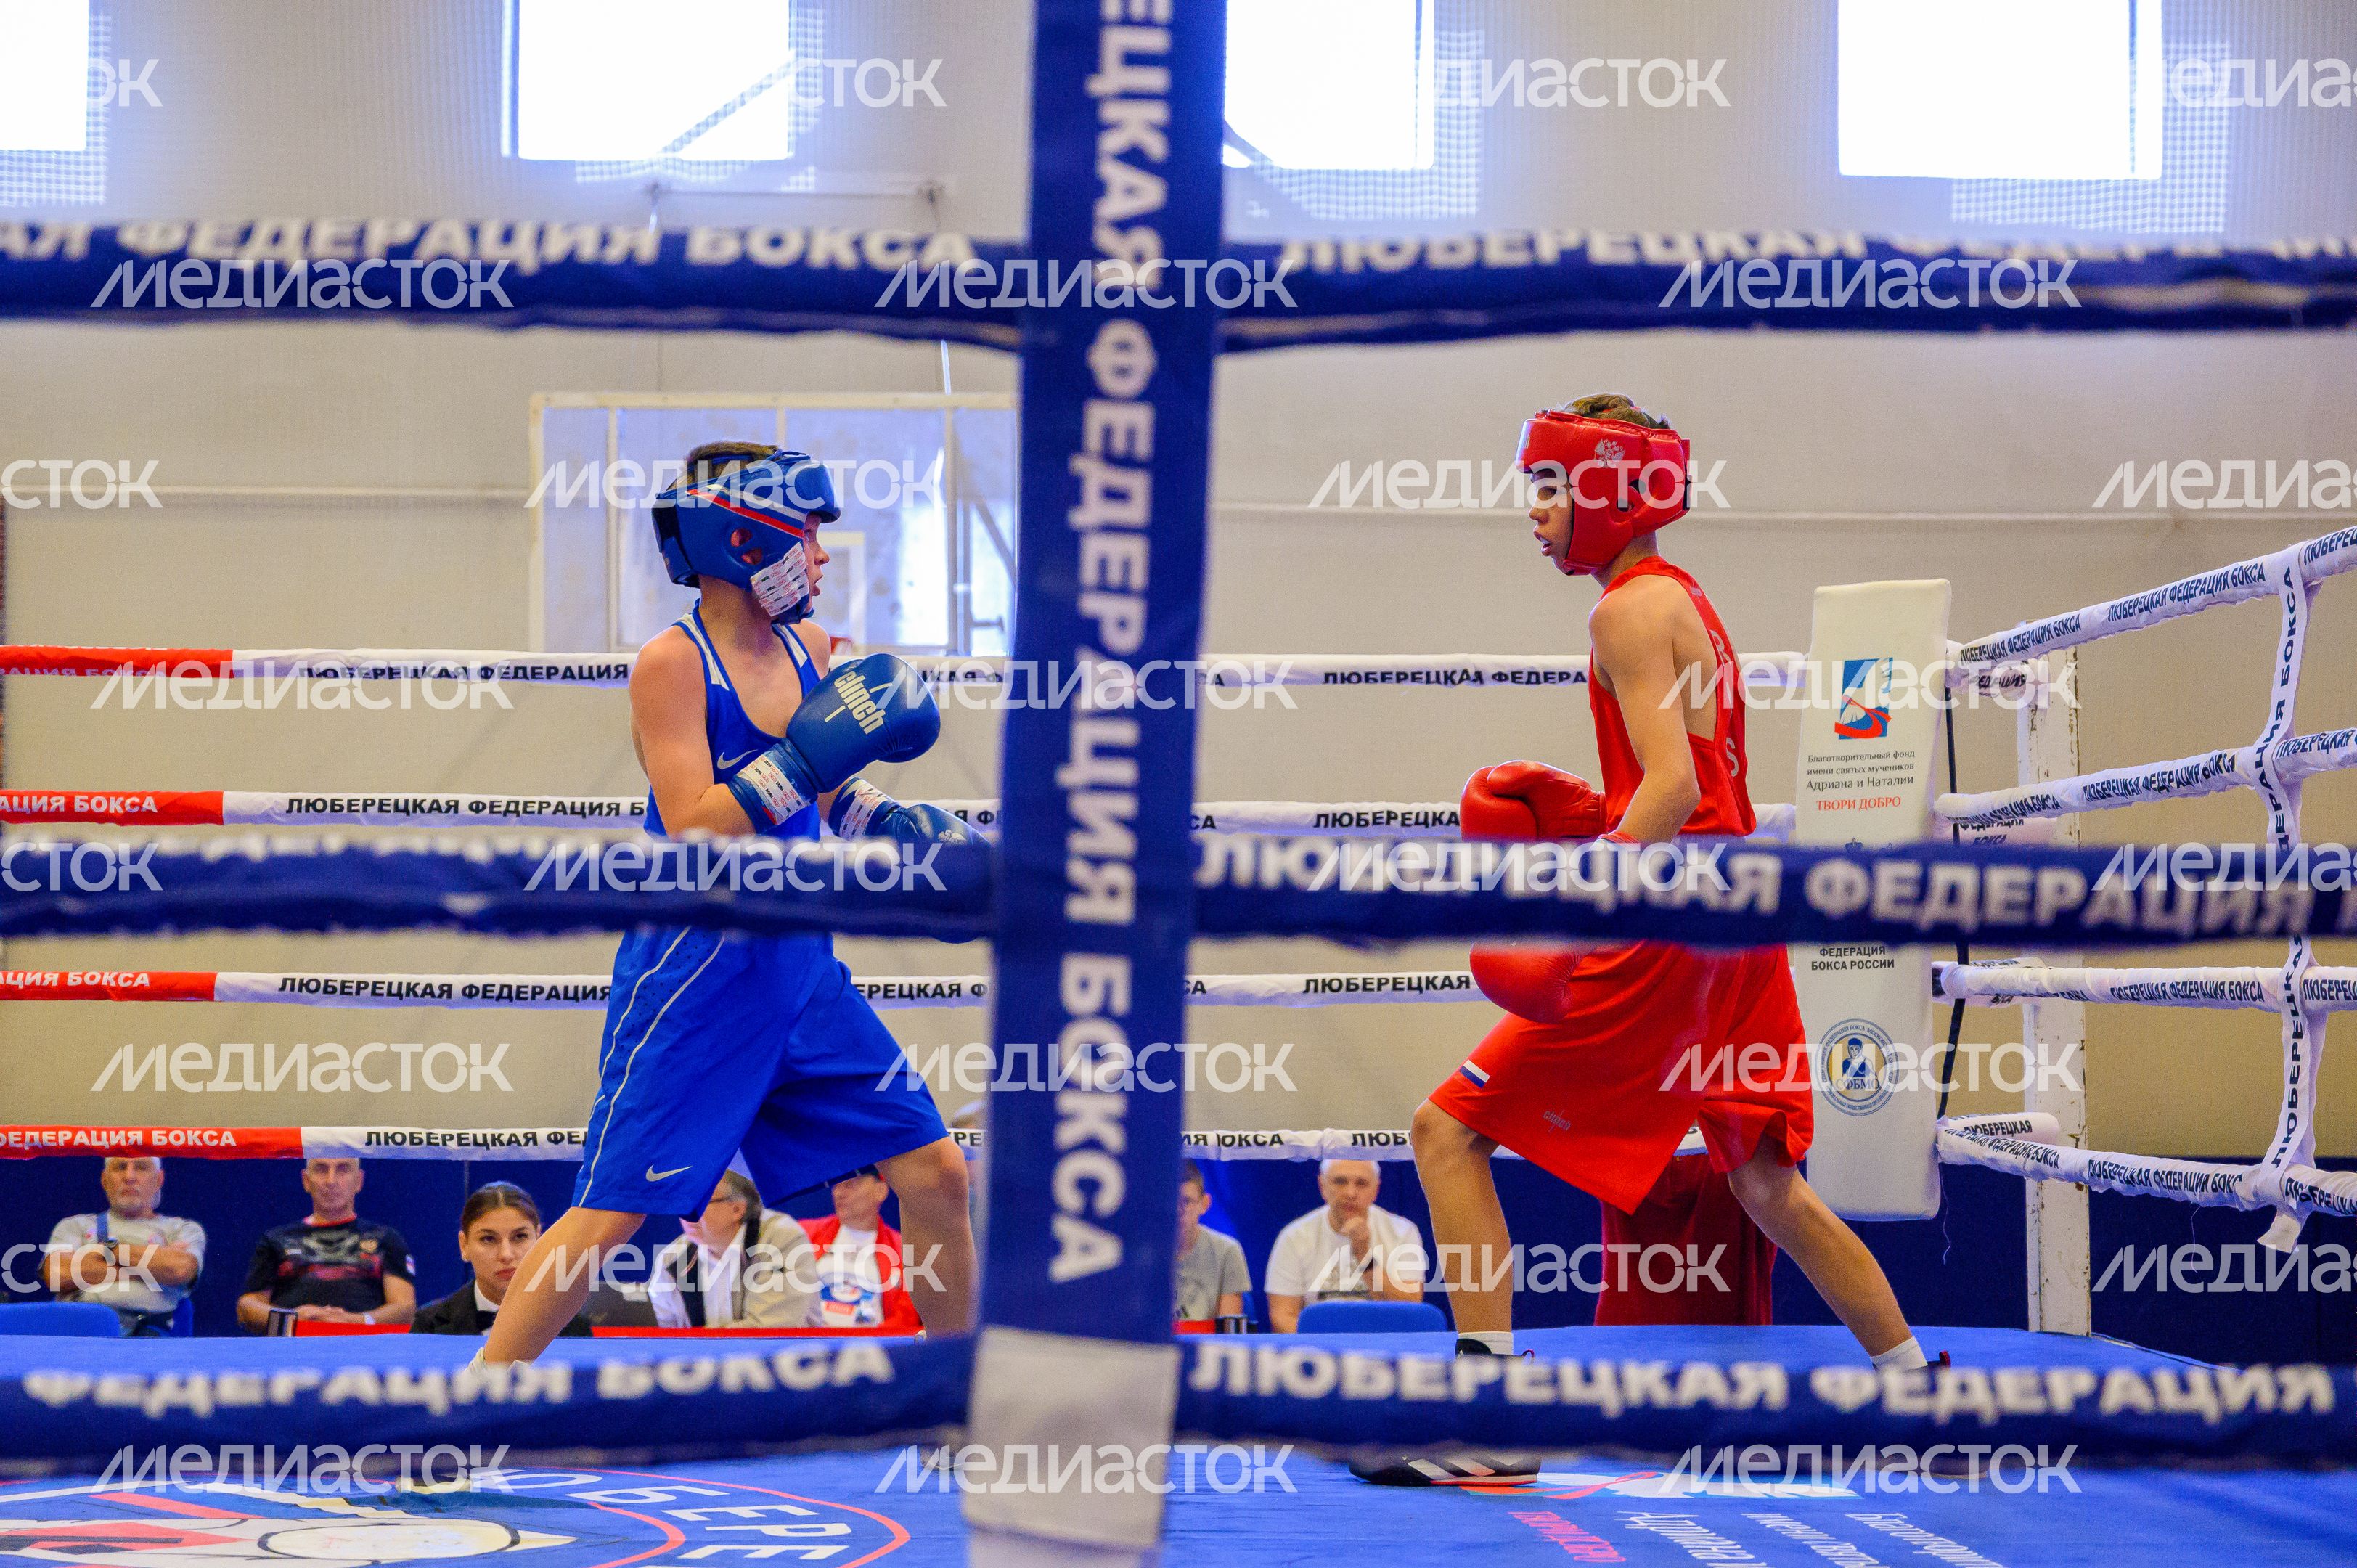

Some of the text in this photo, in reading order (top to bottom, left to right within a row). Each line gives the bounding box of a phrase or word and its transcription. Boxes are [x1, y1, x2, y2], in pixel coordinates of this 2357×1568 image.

[2107, 562, 2266, 622] ЛЮБЕРЕЦКАЯ ФЕДЕРАЦИЯ БОКСА
[1055, 317, 1157, 924] ФЕДЕРАЦИЯ
[2053, 614, 2082, 639] БОКСА
[2281, 565, 2297, 687] БОКСА
[477, 663, 629, 682] ФЕДЕРАЦИЯ
[1322, 668, 1484, 687] ЛЮБЕРЕЦКАЯ
[1807, 749, 1916, 763] Благотворительный фонд
[1807, 764, 1914, 776] имени святых мучеников
[1806, 775, 1914, 791] Адриана и Наталии
[74, 796, 158, 814] БОКСА
[285, 798, 460, 816] ЛЮБЕРЕЦКАЯ
[468, 799, 621, 817] ФЕДЕРАЦИЯ
[1815, 796, 1902, 811] ТВОРИ ДОБРО
[1819, 945, 1886, 958] ФЕДЕРАЦИЯ
[1811, 959, 1895, 971] БОКСА РОССИИ
[67, 971, 150, 987] БОКСА
[1303, 974, 1471, 995] ЛЮБЕРЕЦКАЯ
[278, 977, 611, 1002] ЛЮБЕРЕЦКАЯ ФЕДЕРАЦИЯ
[2228, 980, 2265, 1003] БОКСА
[1047, 952, 1132, 1283] БОКСА
[151, 1130, 237, 1147] БОКСА
[364, 1130, 539, 1151] ЛЮБЕРЕЦКАЯ
[2154, 1169, 2210, 1200] ФЕДЕРАЦИЯ
[597, 1341, 895, 1401] БОКСА
[1188, 1339, 2337, 1427] ЛЮБЕРЕЦКАЯ ФЕДЕРАЦИЯ
